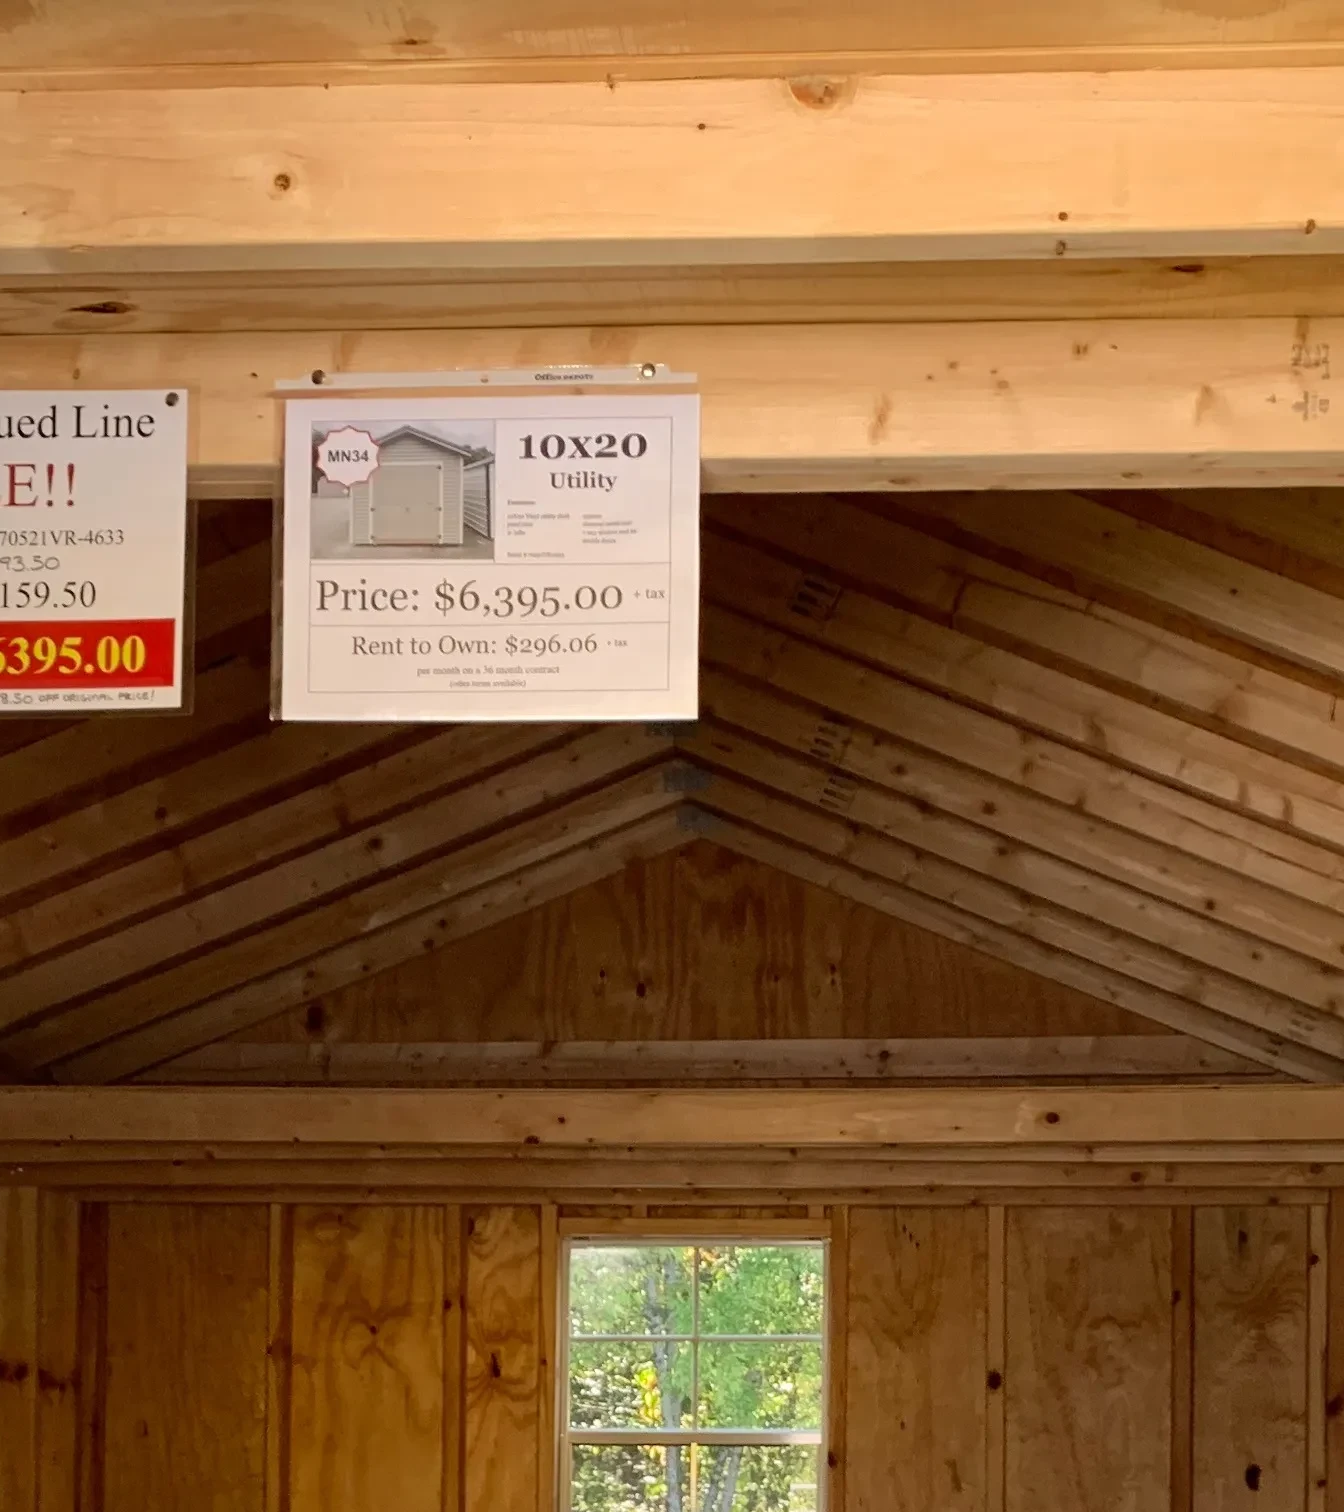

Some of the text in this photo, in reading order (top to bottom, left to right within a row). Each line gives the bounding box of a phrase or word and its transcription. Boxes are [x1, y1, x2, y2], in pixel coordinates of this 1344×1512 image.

[72, 404, 157, 438] Line
[327, 450, 369, 463] MN34
[550, 472, 618, 492] Utility
[316, 579, 419, 611] Price:
[434, 578, 623, 618] $6,395.00
[645, 588, 666, 599] tax
[351, 636, 404, 656] Rent
[410, 638, 432, 655] to
[438, 635, 497, 656] Own:
[505, 633, 598, 658] $296.06
